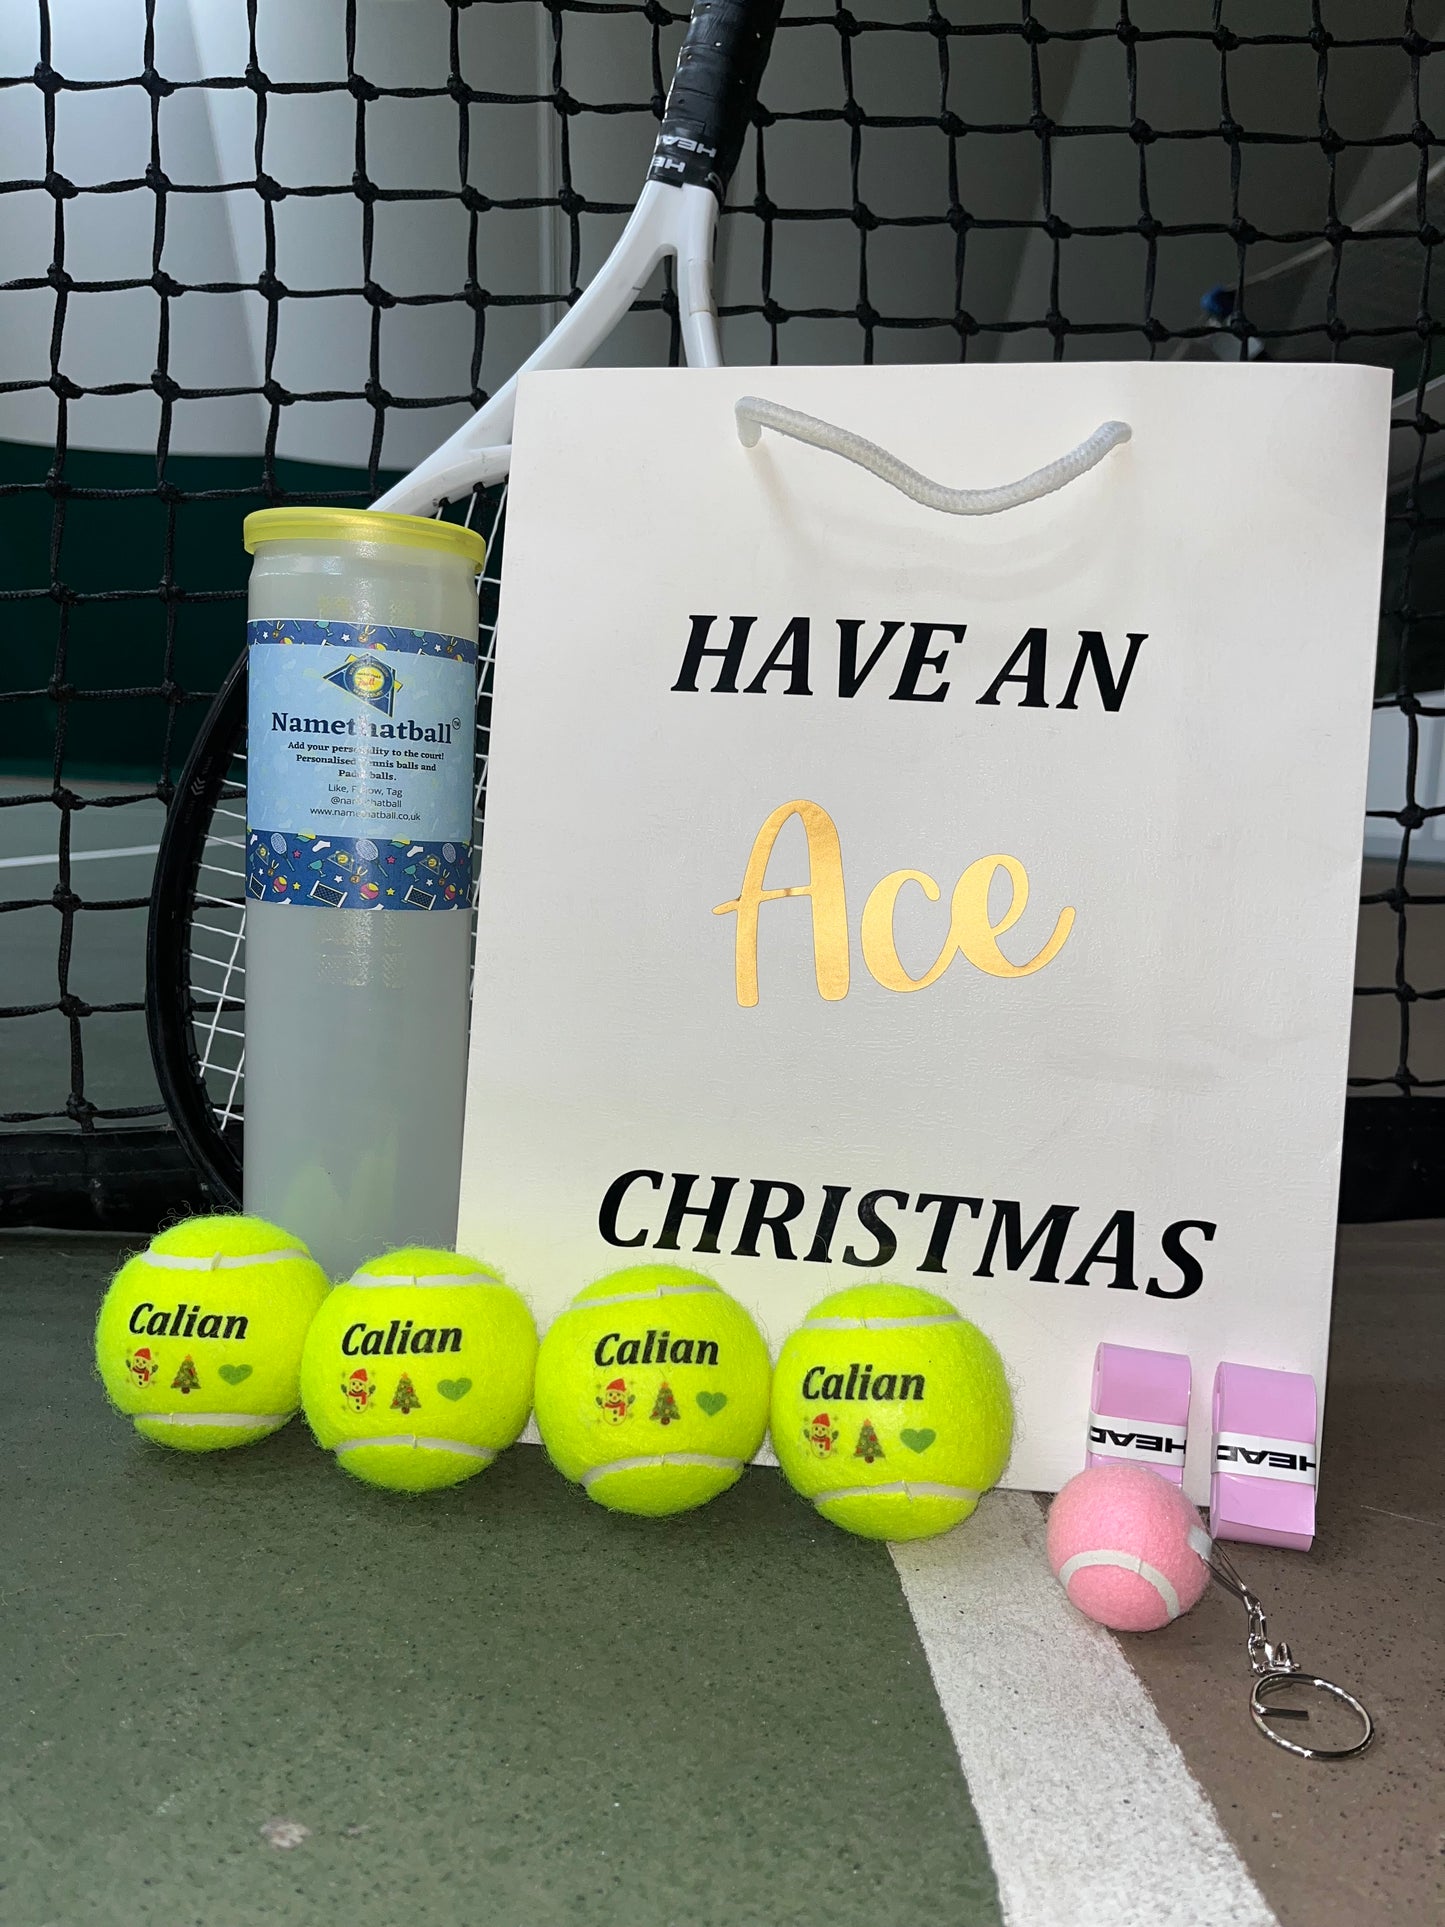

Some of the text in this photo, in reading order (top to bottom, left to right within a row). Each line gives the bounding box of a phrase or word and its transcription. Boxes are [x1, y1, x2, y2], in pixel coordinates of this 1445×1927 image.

[671, 614, 1149, 713] HAVE AN
[287, 741, 445, 760] Add your perslity to the court!
[296, 754, 437, 771] Personalised nnis balls and
[328, 783, 403, 799] Like, Fow, Tag
[338, 769, 397, 781] Pad balls.
[330, 796, 402, 808] @nahatball
[712, 799, 1076, 1008] Ace
[598, 1168, 1218, 1301] CHRISTMAS
[128, 1302, 249, 1340] Calian
[341, 1320, 462, 1356] Calian
[594, 1330, 720, 1367] Calian
[802, 1363, 926, 1401] Calian
[1090, 1425, 1187, 1455] HEAD
[1217, 1444, 1316, 1471] HEAD
